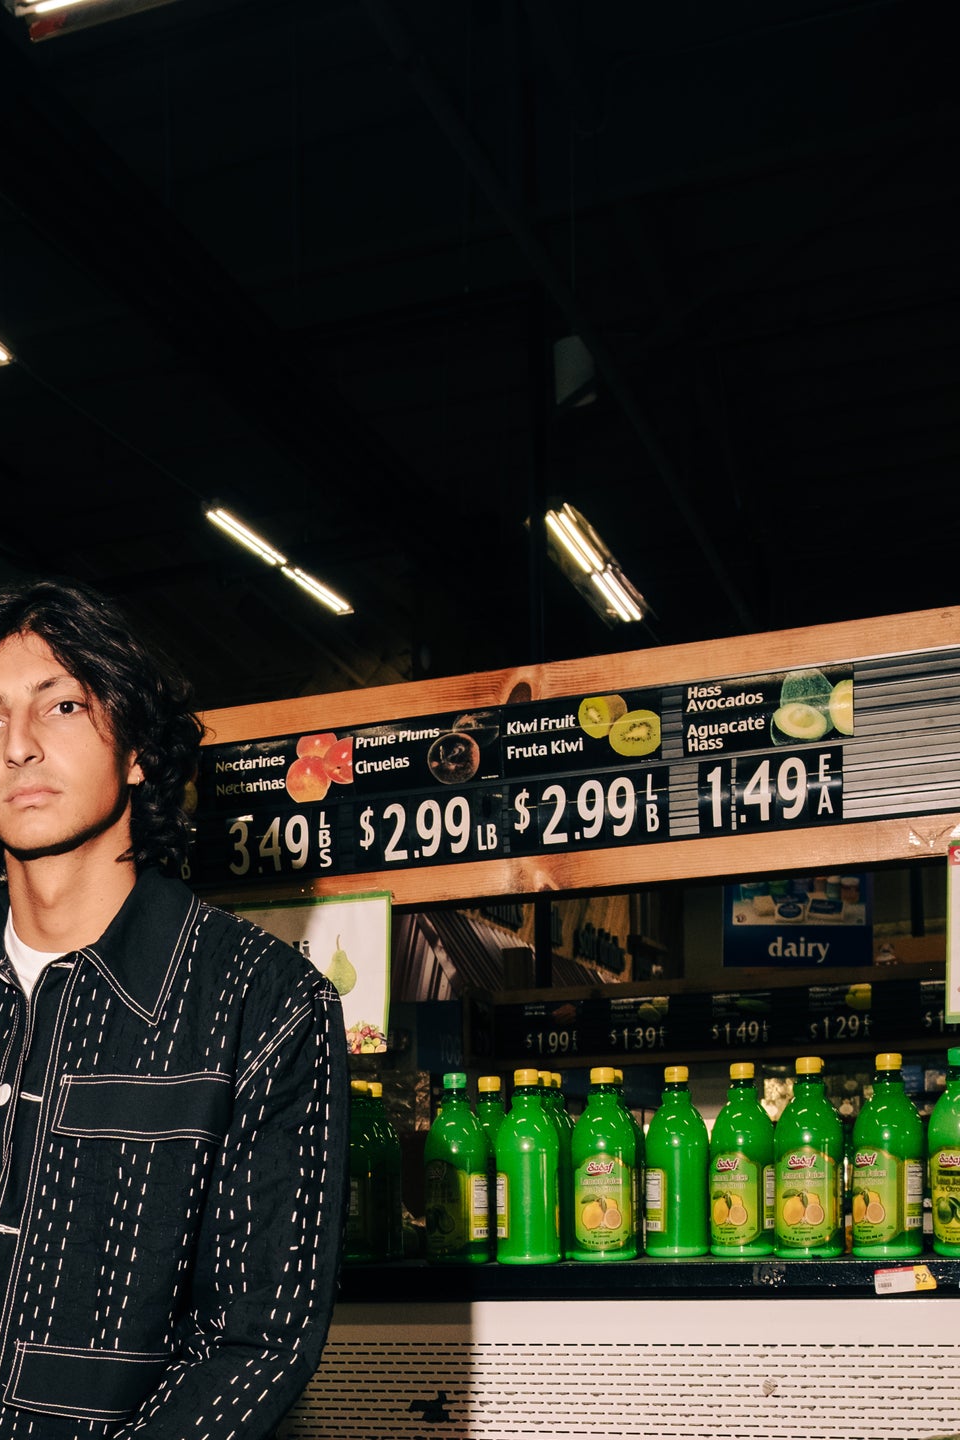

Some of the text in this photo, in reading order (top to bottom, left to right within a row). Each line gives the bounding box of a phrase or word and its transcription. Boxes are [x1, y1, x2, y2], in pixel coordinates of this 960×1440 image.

[686, 691, 764, 713] Avocados
[687, 684, 722, 699] Hass
[506, 714, 576, 736] Kiwi Fruit
[687, 716, 766, 739] Aguacate
[355, 726, 440, 750] Prune Plums
[506, 737, 584, 760] Fruta Kiwi
[688, 736, 724, 752] Hass
[215, 755, 286, 774] Nectarines
[355, 755, 410, 775] Ciruelas
[216, 778, 286, 797] Nectarinas
[706, 756, 806, 828] 1.49
[228, 814, 310, 876] 3.49
[477, 823, 499, 852] LB
[768, 936, 830, 963] dairy
[587, 1161, 614, 1174] Sadaf
[788, 1154, 816, 1168] Sadaf
